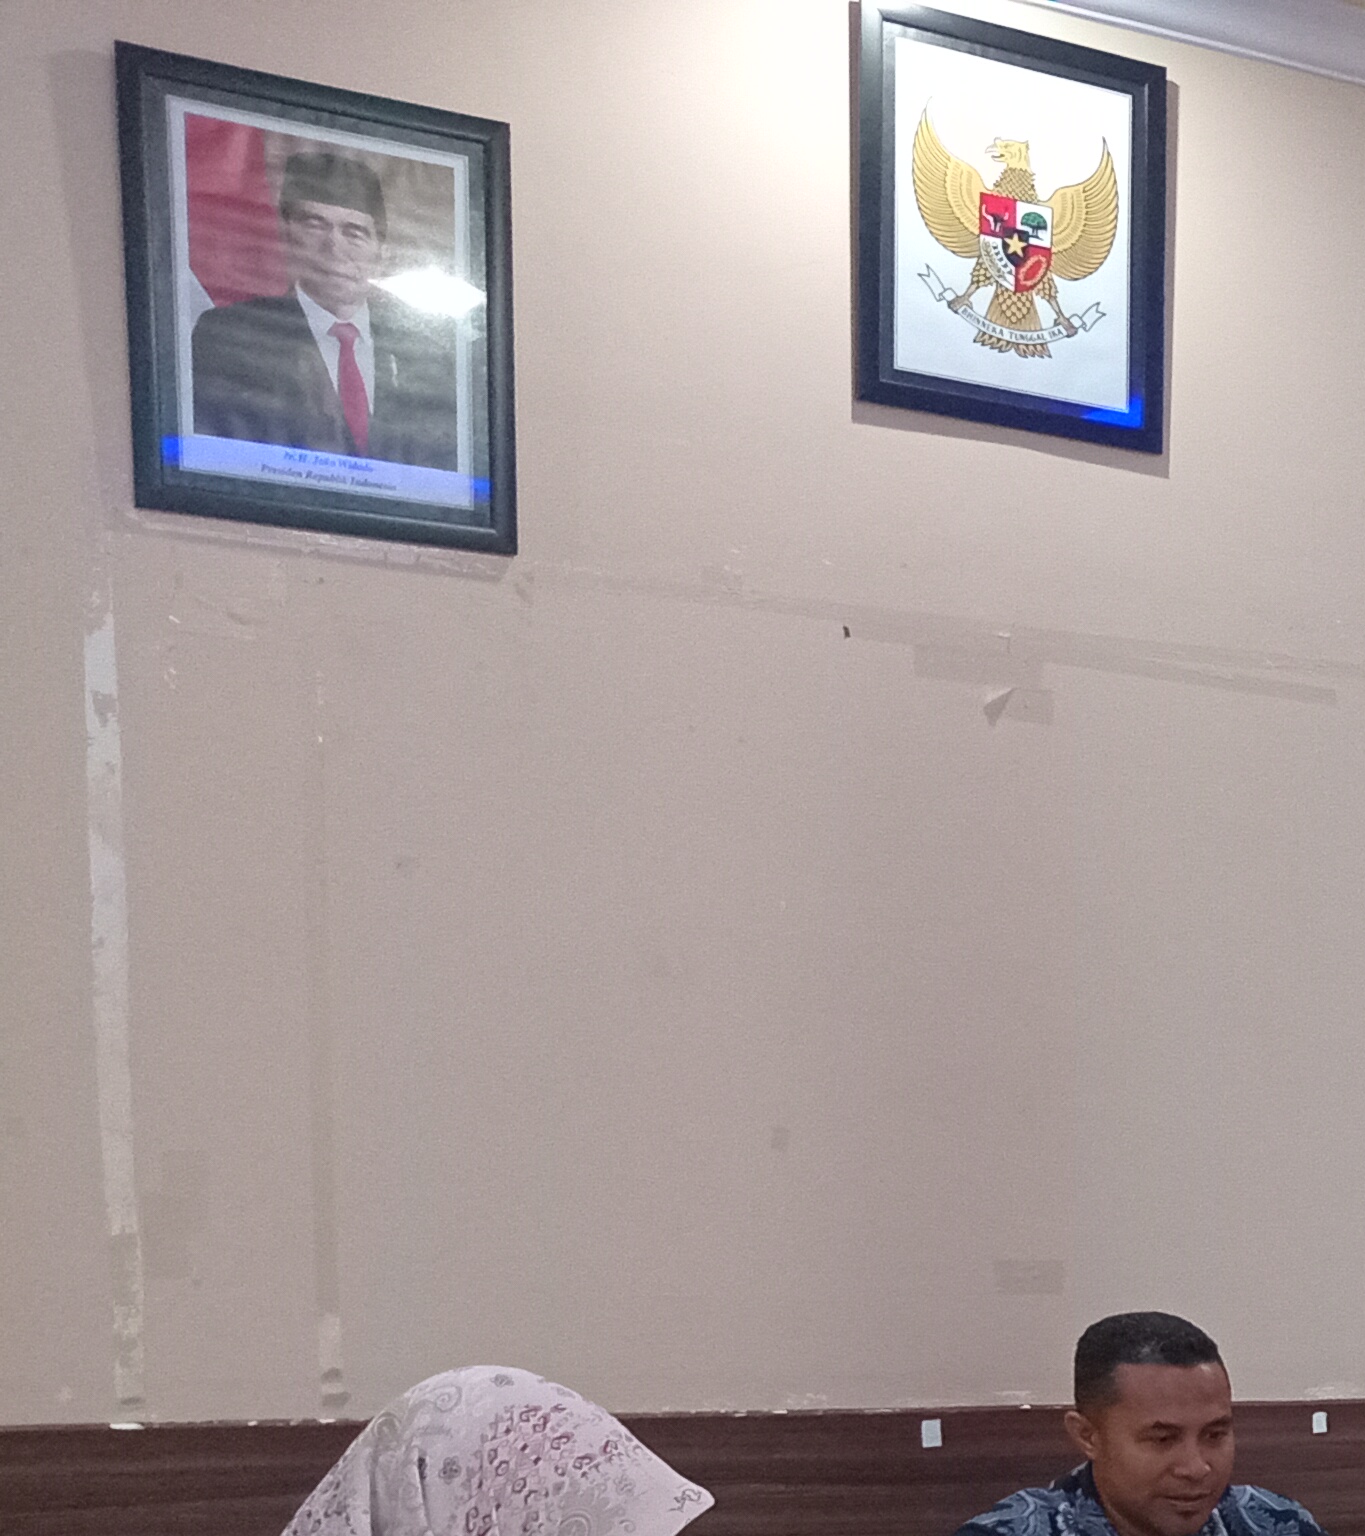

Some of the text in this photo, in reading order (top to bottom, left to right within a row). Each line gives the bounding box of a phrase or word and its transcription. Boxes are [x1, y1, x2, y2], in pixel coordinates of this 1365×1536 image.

[961, 307, 1064, 343] BHINNEKA TUNGGAL IKA
